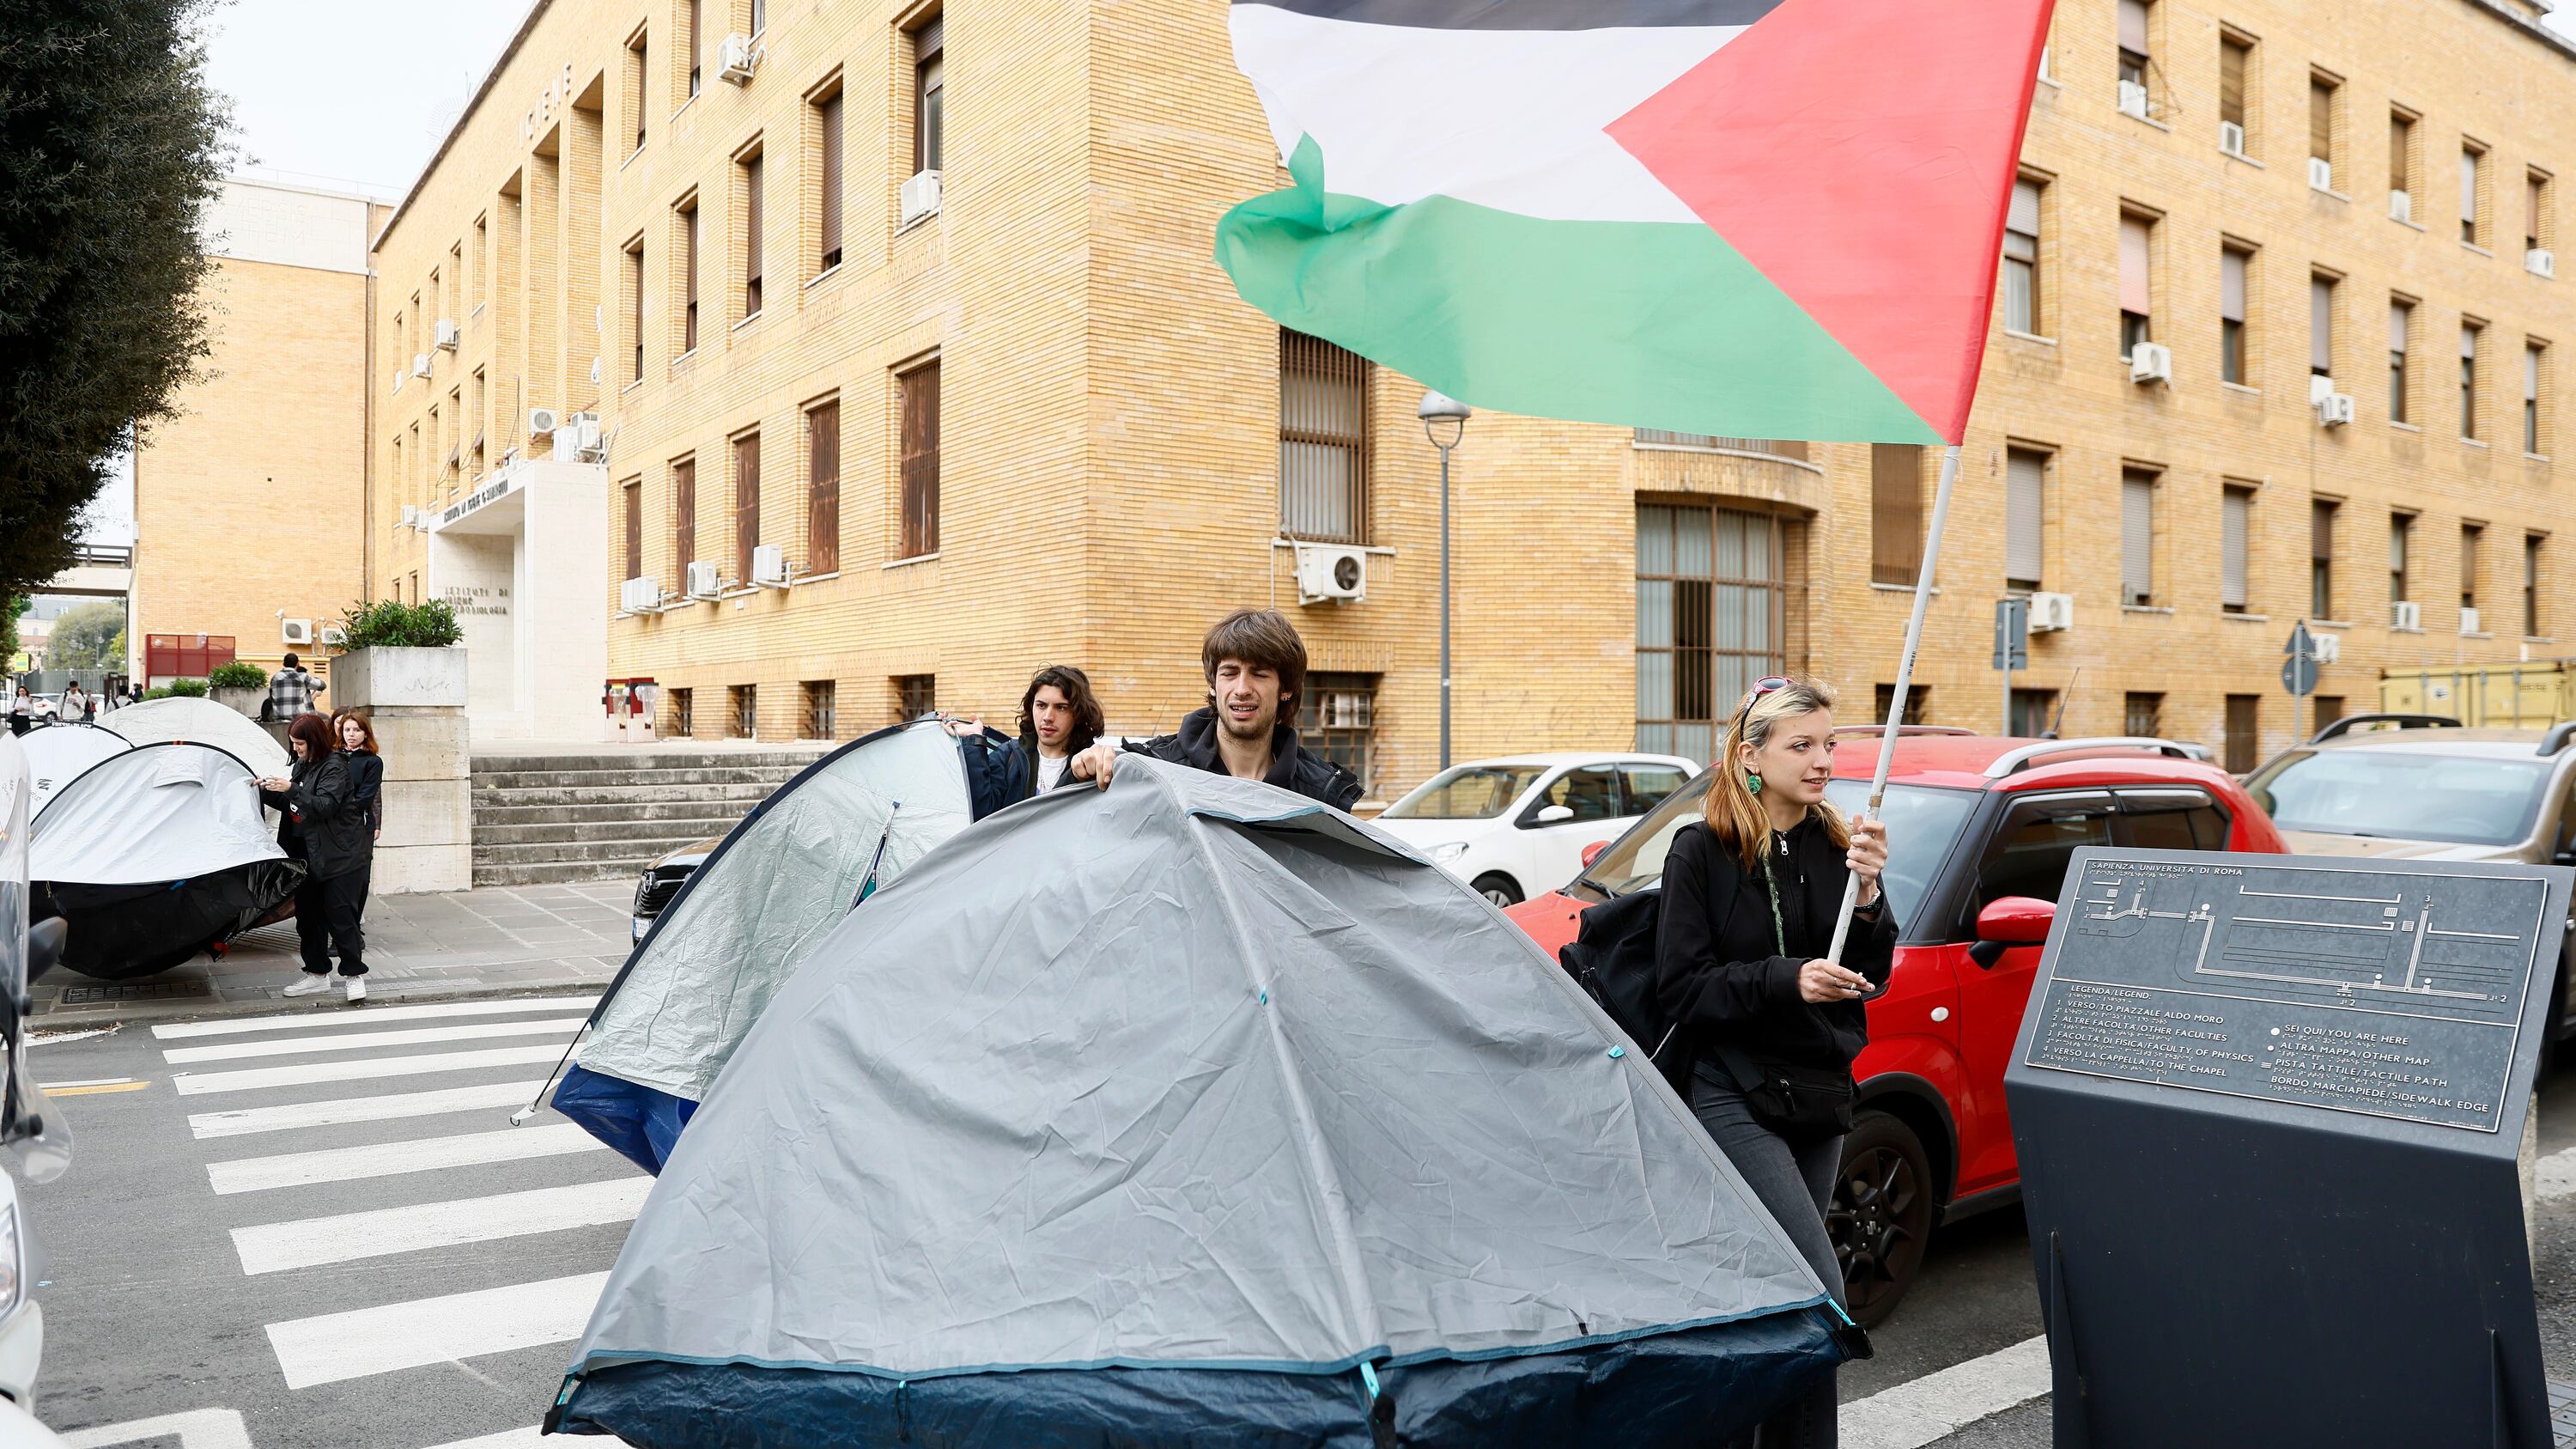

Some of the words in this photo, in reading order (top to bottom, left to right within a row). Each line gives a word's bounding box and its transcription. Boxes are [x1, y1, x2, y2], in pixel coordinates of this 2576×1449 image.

[519, 62, 572, 149] IGIENE
[455, 605, 507, 614] CROBIOLOGIA
[2071, 985, 2151, 1000] LEGENDA/LEGEND:
[2068, 1001, 2113, 1012] VERSO/TO
[2116, 1005, 2161, 1017] PIAZZALE
[2164, 1011, 2191, 1020] ALDO
[2194, 1014, 2224, 1024] MORO
[2063, 1016, 2090, 1026] ALTRE
[2175, 1029, 2227, 1041] FACULTIES
[2284, 1024, 2300, 1032] SEI
[2304, 1026, 2352, 1038] QUI/YOU
[2355, 1032, 2377, 1042] ARE
[2381, 1035, 2409, 1045] HERE
[2054, 1047, 2082, 1056] VERSO
[2099, 1052, 2164, 1068] CAPPELLA/TO
[2168, 1062, 2186, 1071] THE
[2190, 1065, 2227, 1077] CHAPEL
[2115, 1038, 2192, 1053] FISICA/FACULTY
[2196, 1048, 2209, 1056] OF
[2212, 1050, 2254, 1062] PHYSICS
[2280, 1042, 2316, 1052] ALTRA
[2319, 1046, 2401, 1063] MAPPA/OTHER
[2405, 1055, 2430, 1066] MAP
[2275, 1058, 2306, 1068] PISTA
[2312, 1062, 2411, 1083] TATTILE/TACTILE
[2415, 1075, 2448, 1087] PATH
[2270, 1075, 2309, 1087] BORDO
[2313, 1081, 2451, 1107] MARCIAPIEDE/SIDEWALK
[2457, 1100, 2489, 1112] EDGE
